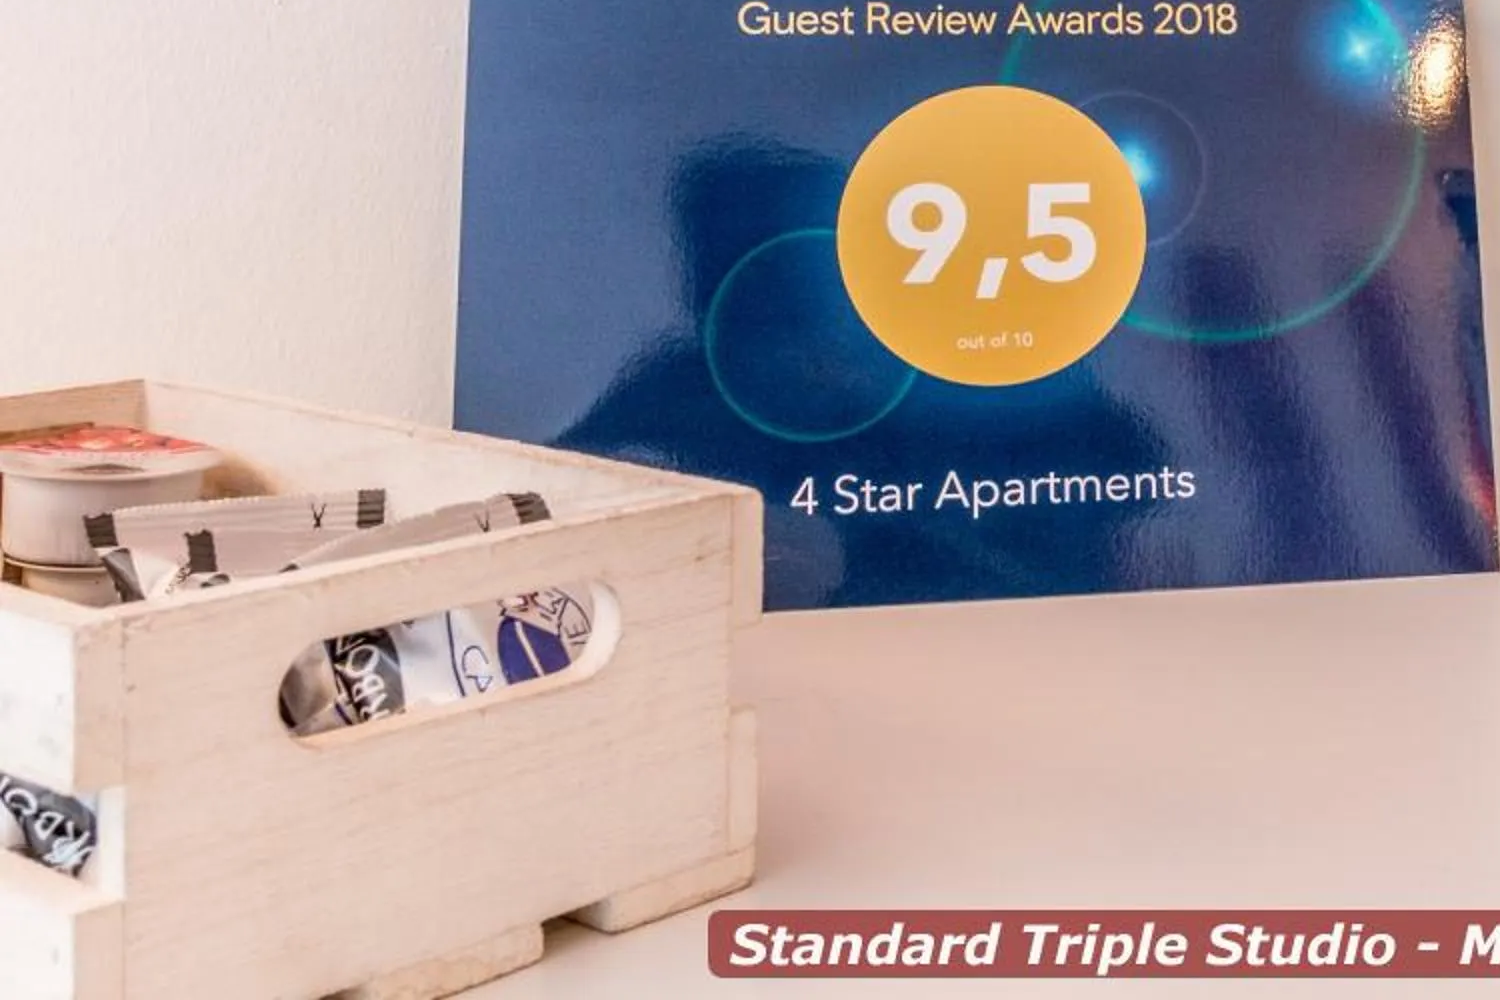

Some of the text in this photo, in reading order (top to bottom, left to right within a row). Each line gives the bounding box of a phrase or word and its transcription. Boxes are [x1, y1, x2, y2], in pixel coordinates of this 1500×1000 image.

[737, 1, 1239, 36] Guest Review Awards 2018
[886, 181, 1097, 299] 9,5
[956, 331, 1033, 350] out of 10
[790, 465, 1196, 520] 4 Star Apartments
